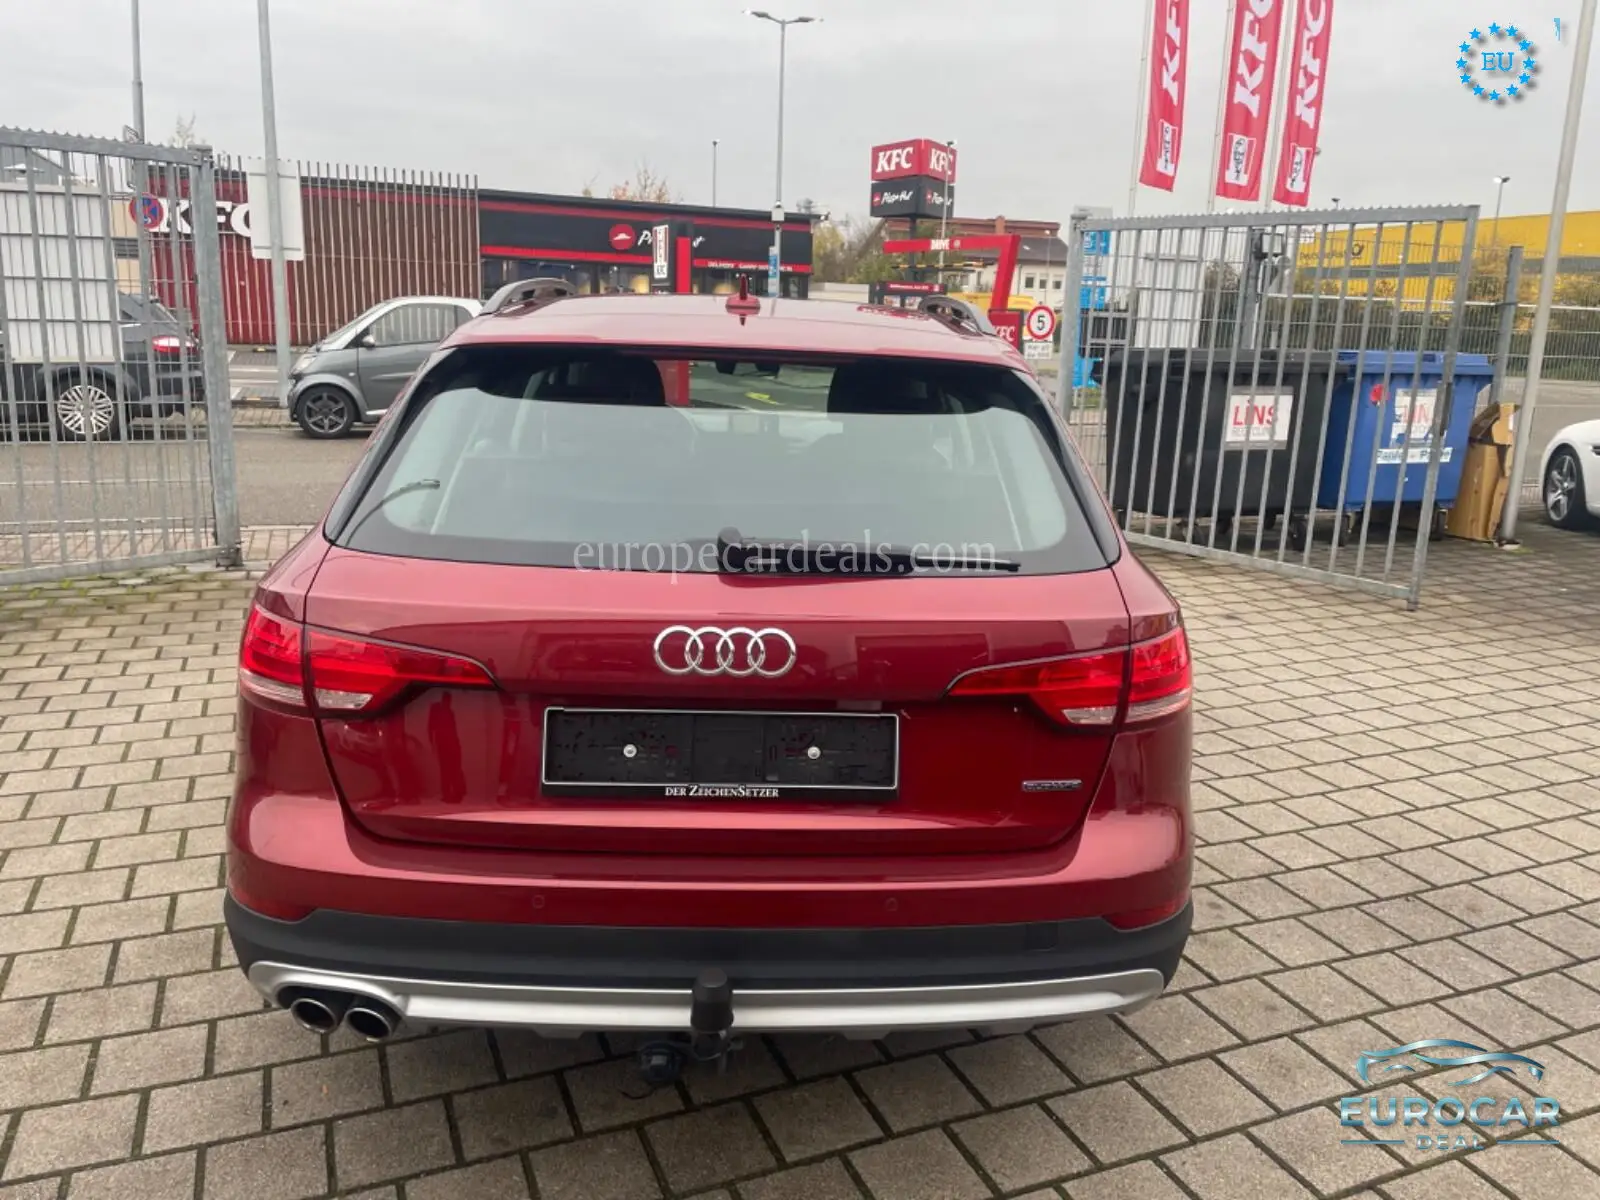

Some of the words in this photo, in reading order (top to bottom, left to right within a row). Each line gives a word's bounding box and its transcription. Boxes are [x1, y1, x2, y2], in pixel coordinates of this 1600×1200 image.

[1295, 0, 1326, 129] KFC
[876, 146, 914, 174] KFC
[1036, 314, 1046, 331] 5
[665, 786, 687, 796] DER
